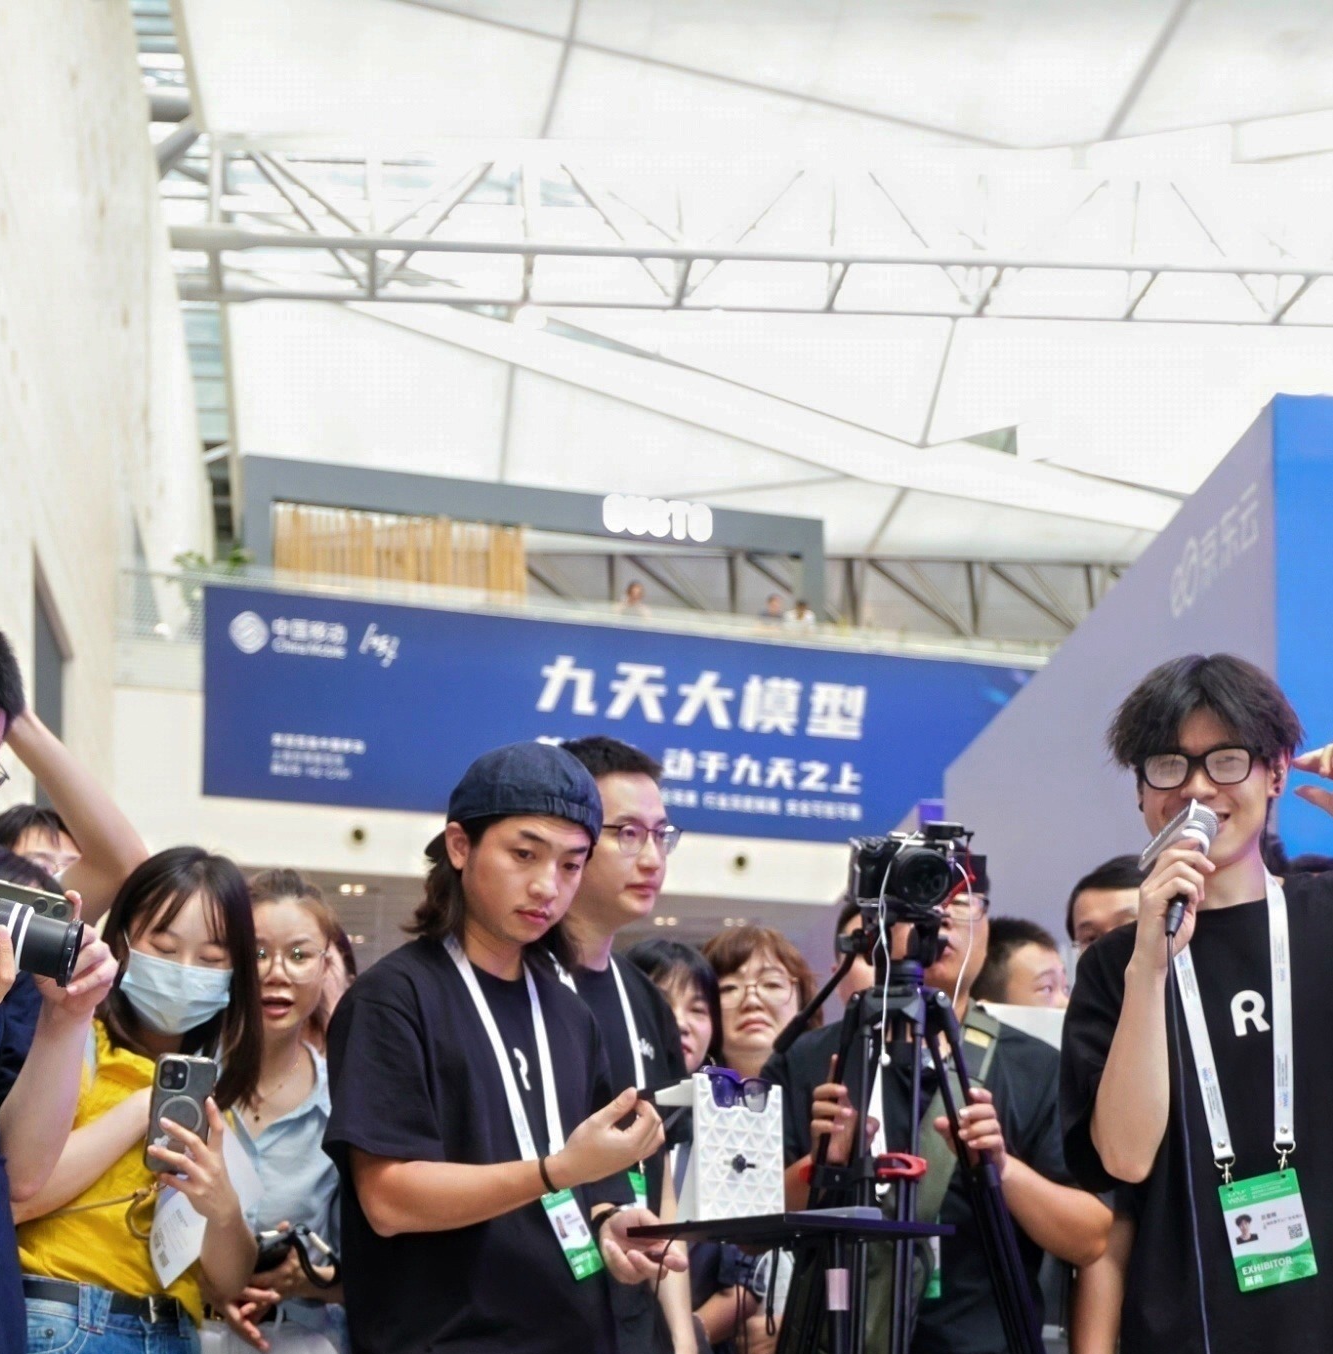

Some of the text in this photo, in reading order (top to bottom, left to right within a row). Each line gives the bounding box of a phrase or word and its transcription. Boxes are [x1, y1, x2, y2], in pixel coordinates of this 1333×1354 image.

[536, 655, 868, 740] 九天大模型
[1230, 990, 1271, 1037] R
[1241, 1255, 1294, 1276] EXHIBITOR
